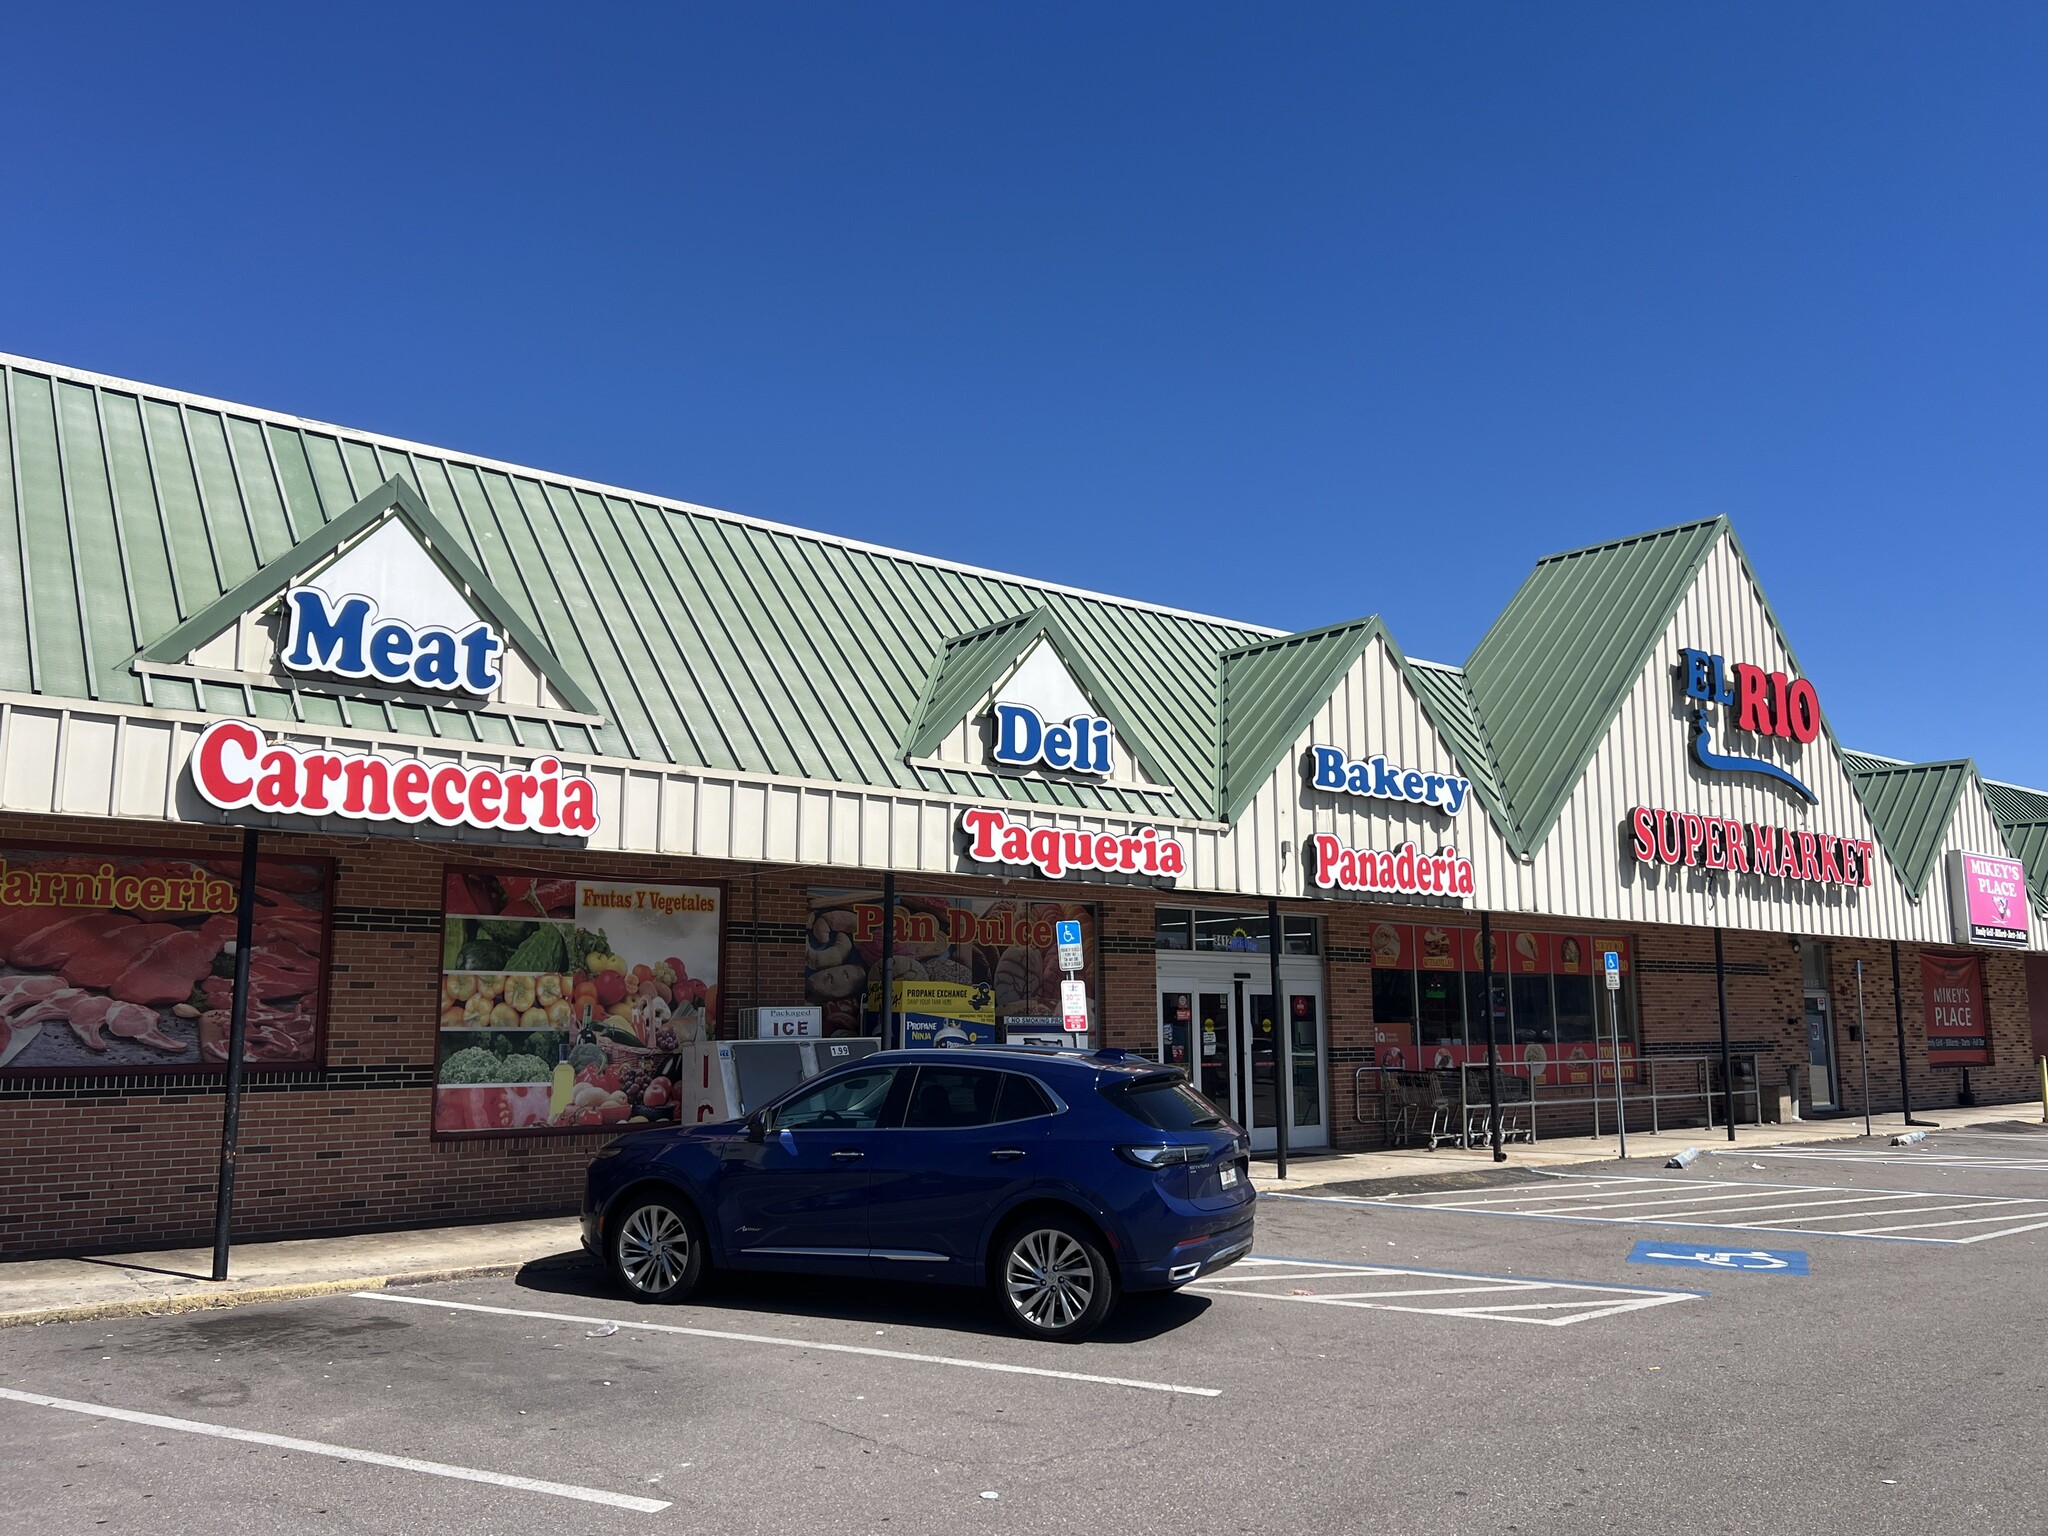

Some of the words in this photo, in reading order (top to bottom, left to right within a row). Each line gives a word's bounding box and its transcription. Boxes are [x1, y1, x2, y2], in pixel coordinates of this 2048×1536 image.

[288, 591, 499, 690] Meat
[1682, 647, 1735, 707] EL
[1736, 662, 1821, 744] RIO
[995, 704, 1112, 773] Deli
[199, 722, 597, 832] Carneceria
[1313, 746, 1470, 814] Bakery
[965, 809, 1185, 877] Taqueria
[1633, 805, 1749, 873] SUPER
[1751, 822, 1874, 887] MARKET
[1315, 834, 1475, 895] Panaderia
[1970, 859, 2020, 880] MIKEY'S
[0, 857, 237, 913] arniceria
[1978, 878, 2017, 898] PLACE
[582, 888, 632, 909] Frutas
[636, 891, 646, 909] Y
[649, 891, 715, 915] Vegetales
[853, 903, 937, 943] Pan
[946, 908, 1054, 948] Dulce
[906, 989, 936, 998] PROPANE
[936, 989, 968, 998] EXCHANGE
[1933, 987, 1970, 1004] MIKEY'S
[770, 1009, 811, 1018] Packaged
[906, 1021, 938, 1031] PROPANE
[1935, 1007, 1972, 1027] PLACE
[773, 1021, 809, 1036] ICE
[911, 1031, 932, 1041] NINJA
[832, 1046, 849, 1056] 1.99
